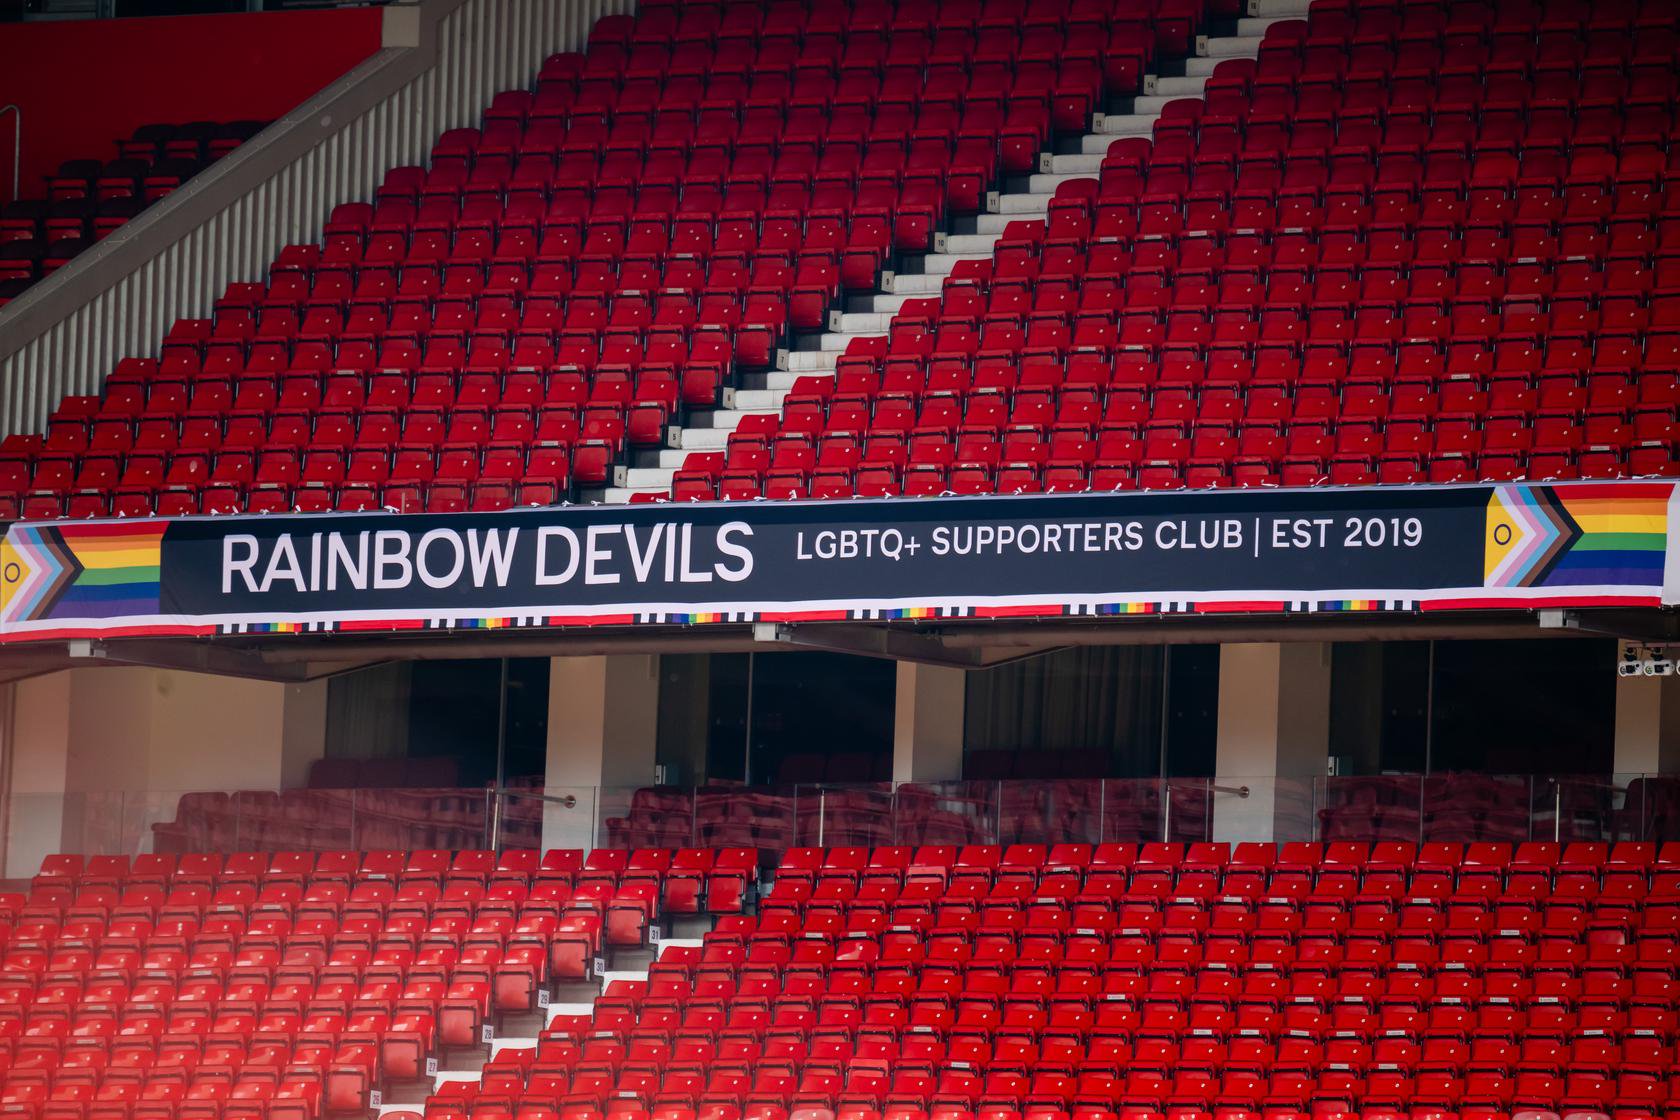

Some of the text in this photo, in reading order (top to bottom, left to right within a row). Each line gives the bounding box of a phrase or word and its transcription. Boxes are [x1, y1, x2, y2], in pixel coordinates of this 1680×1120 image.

[222, 521, 755, 594] RAINBOW DEVILS
[796, 527, 921, 562] LGBTQ+
[931, 521, 1144, 555] SUPPORTERS
[1155, 519, 1243, 550] CLUB
[1272, 518, 1334, 549] EST
[1343, 517, 1423, 547] 2019
